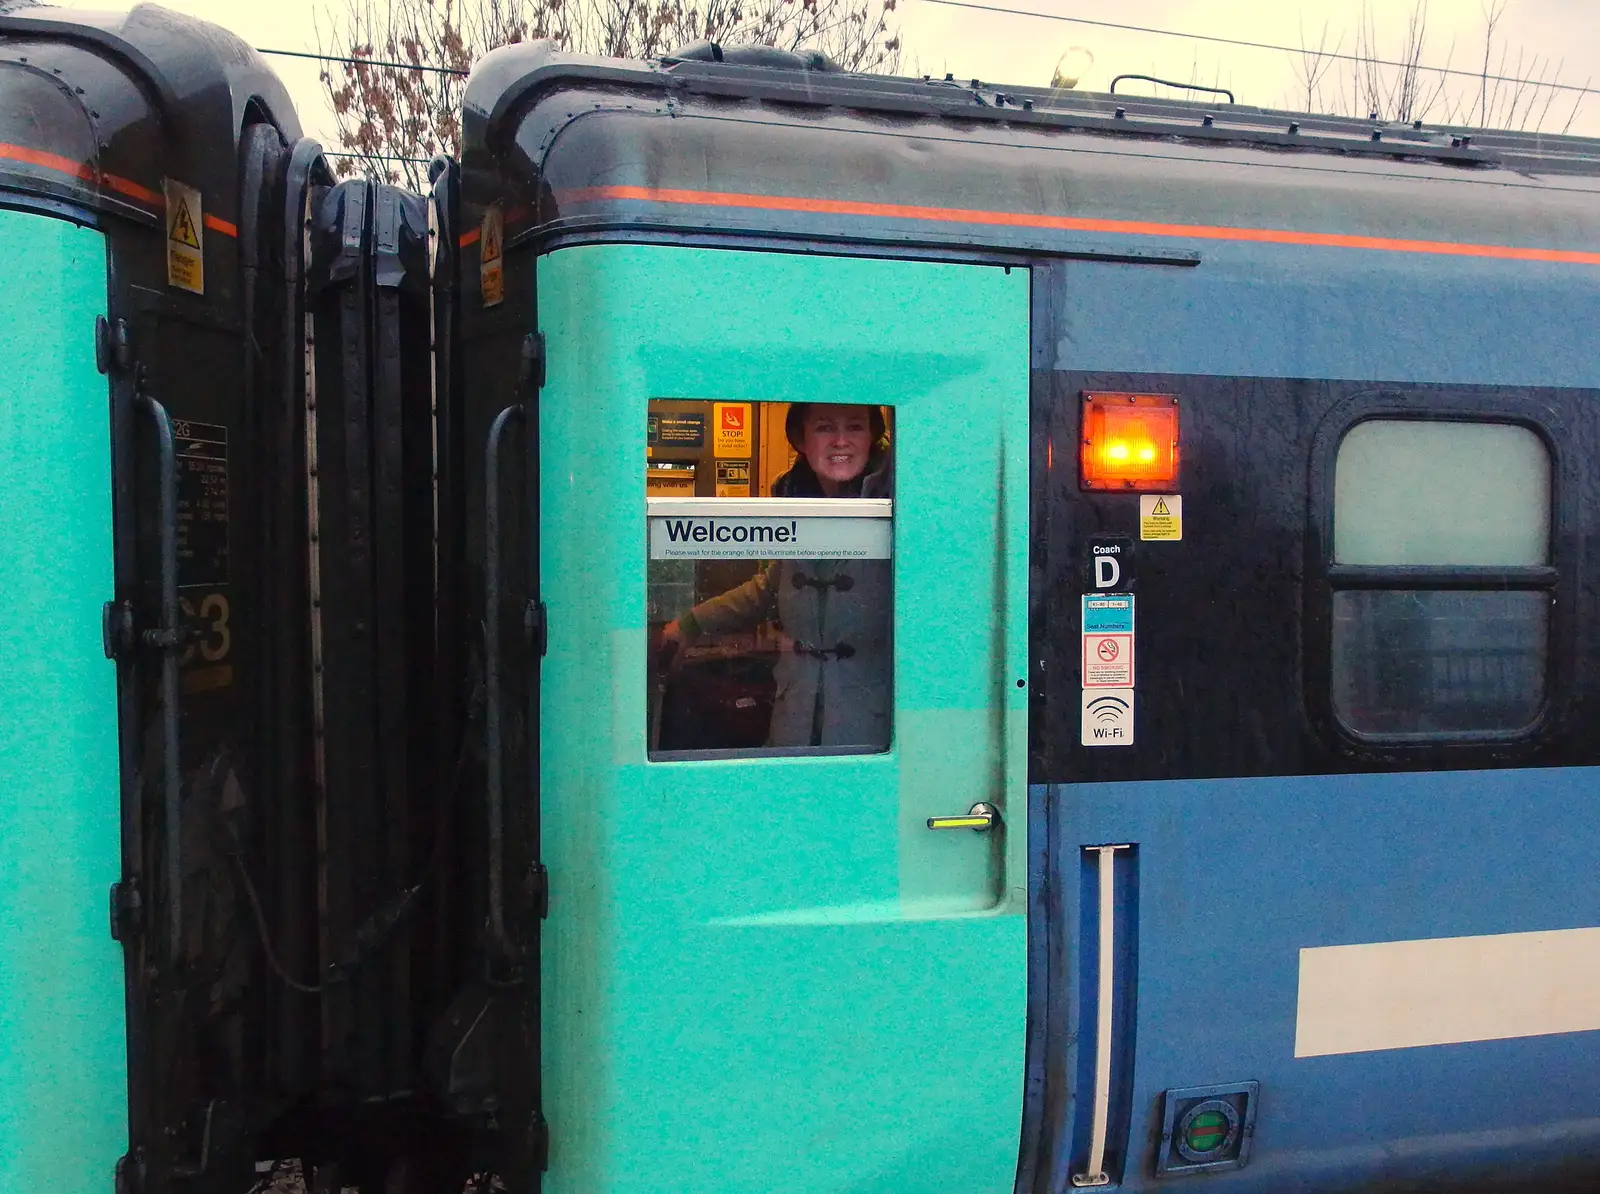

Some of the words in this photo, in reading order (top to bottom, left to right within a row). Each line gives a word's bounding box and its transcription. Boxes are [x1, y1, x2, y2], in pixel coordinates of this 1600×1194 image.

[666, 520, 797, 542] Welcome!
[1093, 545, 1121, 554] Coach
[1095, 556, 1120, 588] D
[1093, 728, 1123, 738] Wi-Fi
